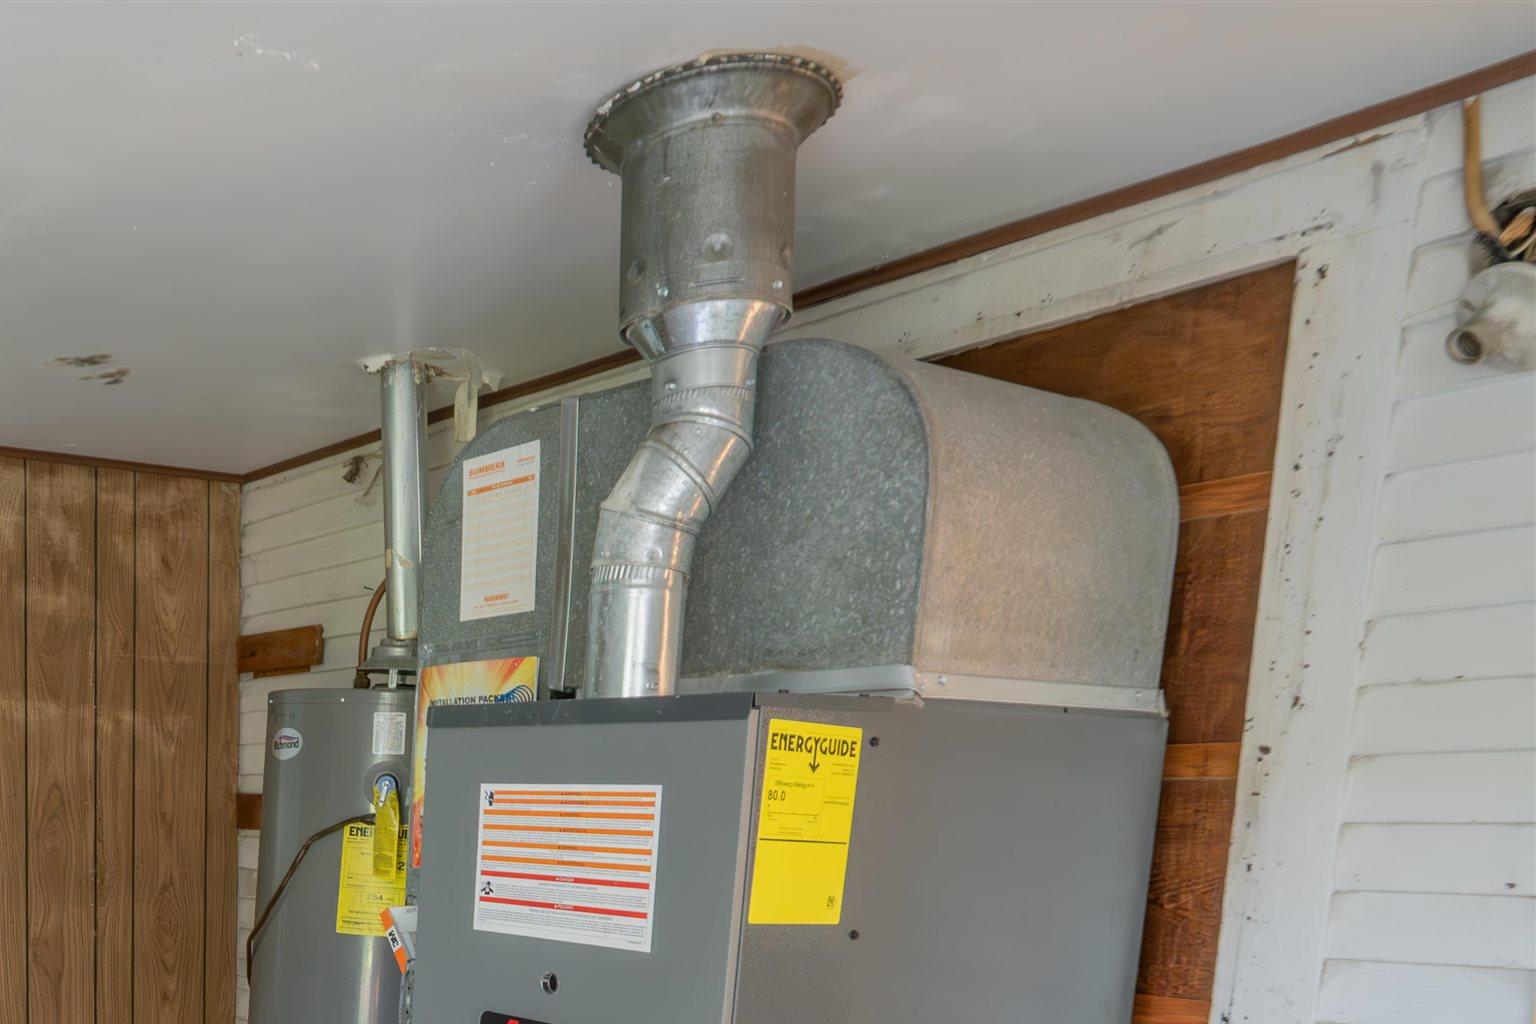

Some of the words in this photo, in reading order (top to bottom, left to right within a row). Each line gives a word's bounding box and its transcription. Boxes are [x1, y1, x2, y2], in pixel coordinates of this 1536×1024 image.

[468, 460, 506, 477] SUMMERS
[274, 738, 299, 750] Richmond
[770, 732, 857, 757] ENERGYGUIDE
[767, 789, 786, 801] 80.0
[388, 930, 399, 948] 3M
